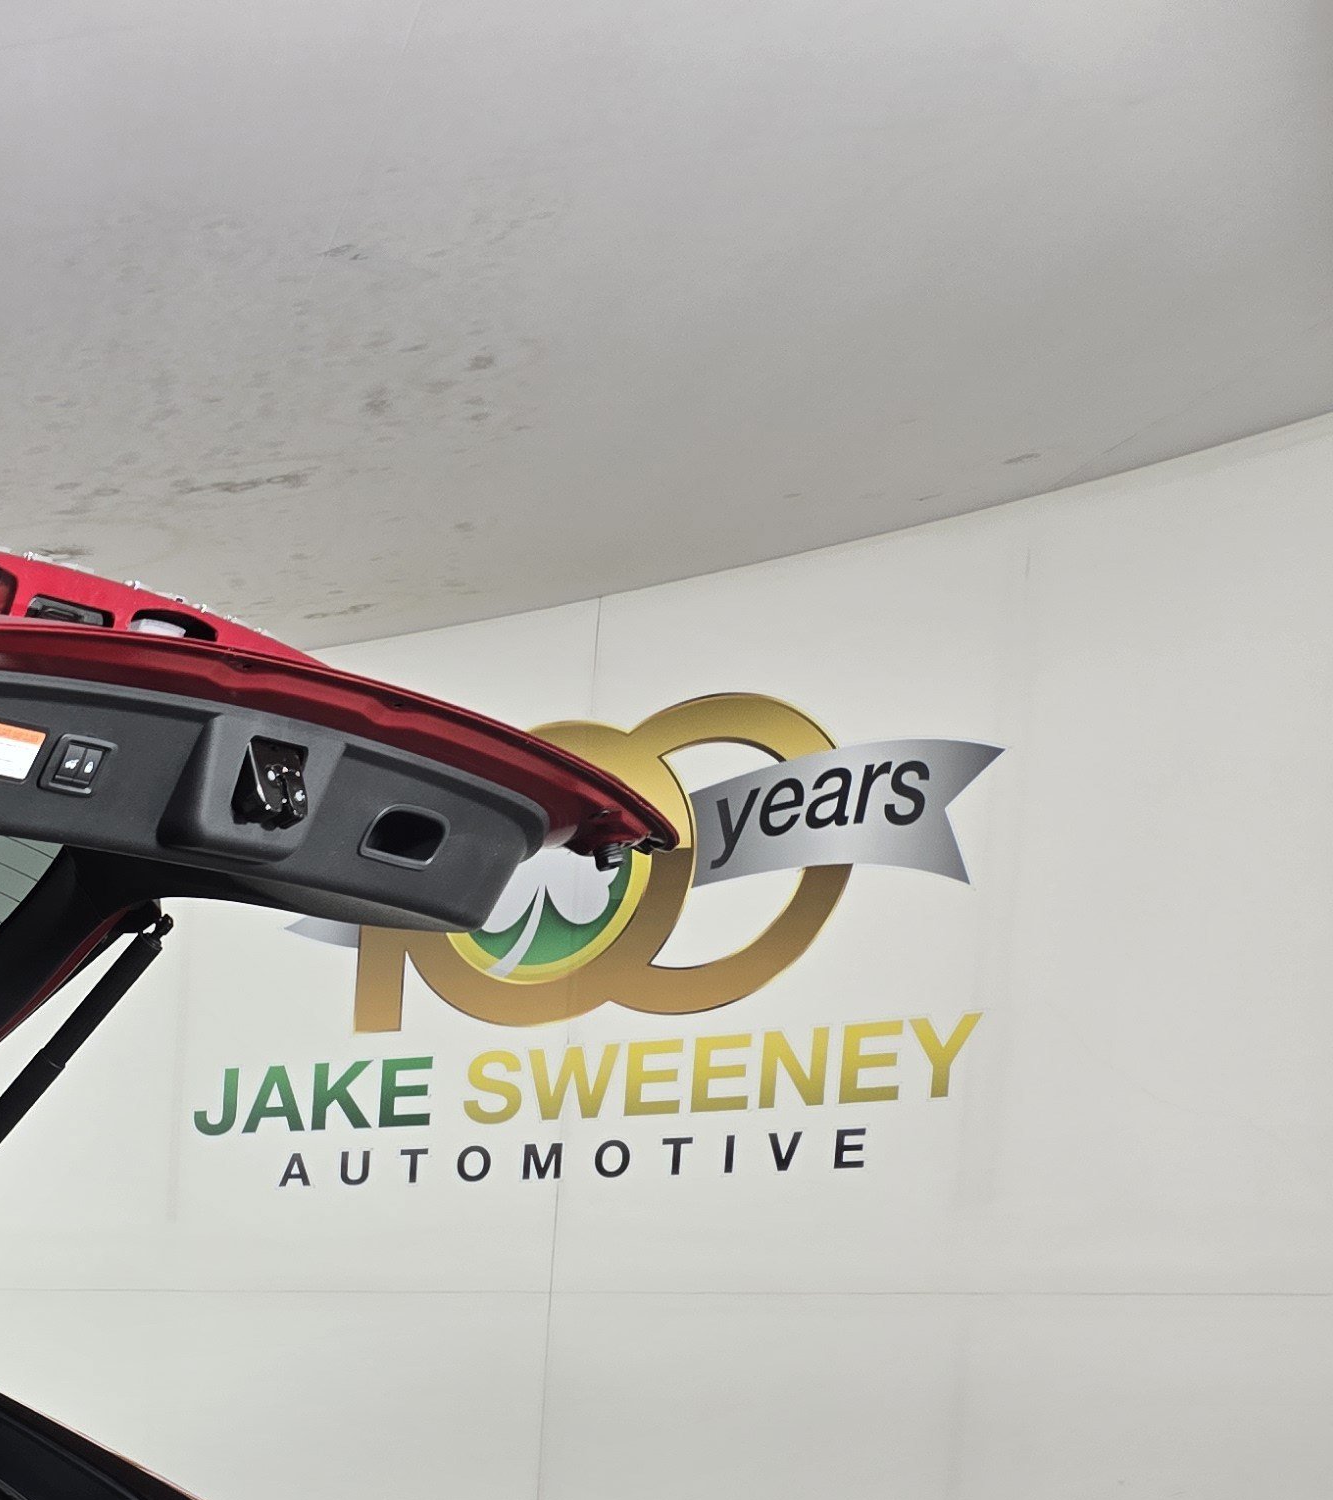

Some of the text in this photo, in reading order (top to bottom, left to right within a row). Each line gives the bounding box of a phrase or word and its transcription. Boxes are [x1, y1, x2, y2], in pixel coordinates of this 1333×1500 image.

[709, 759, 930, 871] years
[193, 1011, 984, 1136] JAKE SWEENEY
[277, 1127, 868, 1188] AUTOMOTIVE
